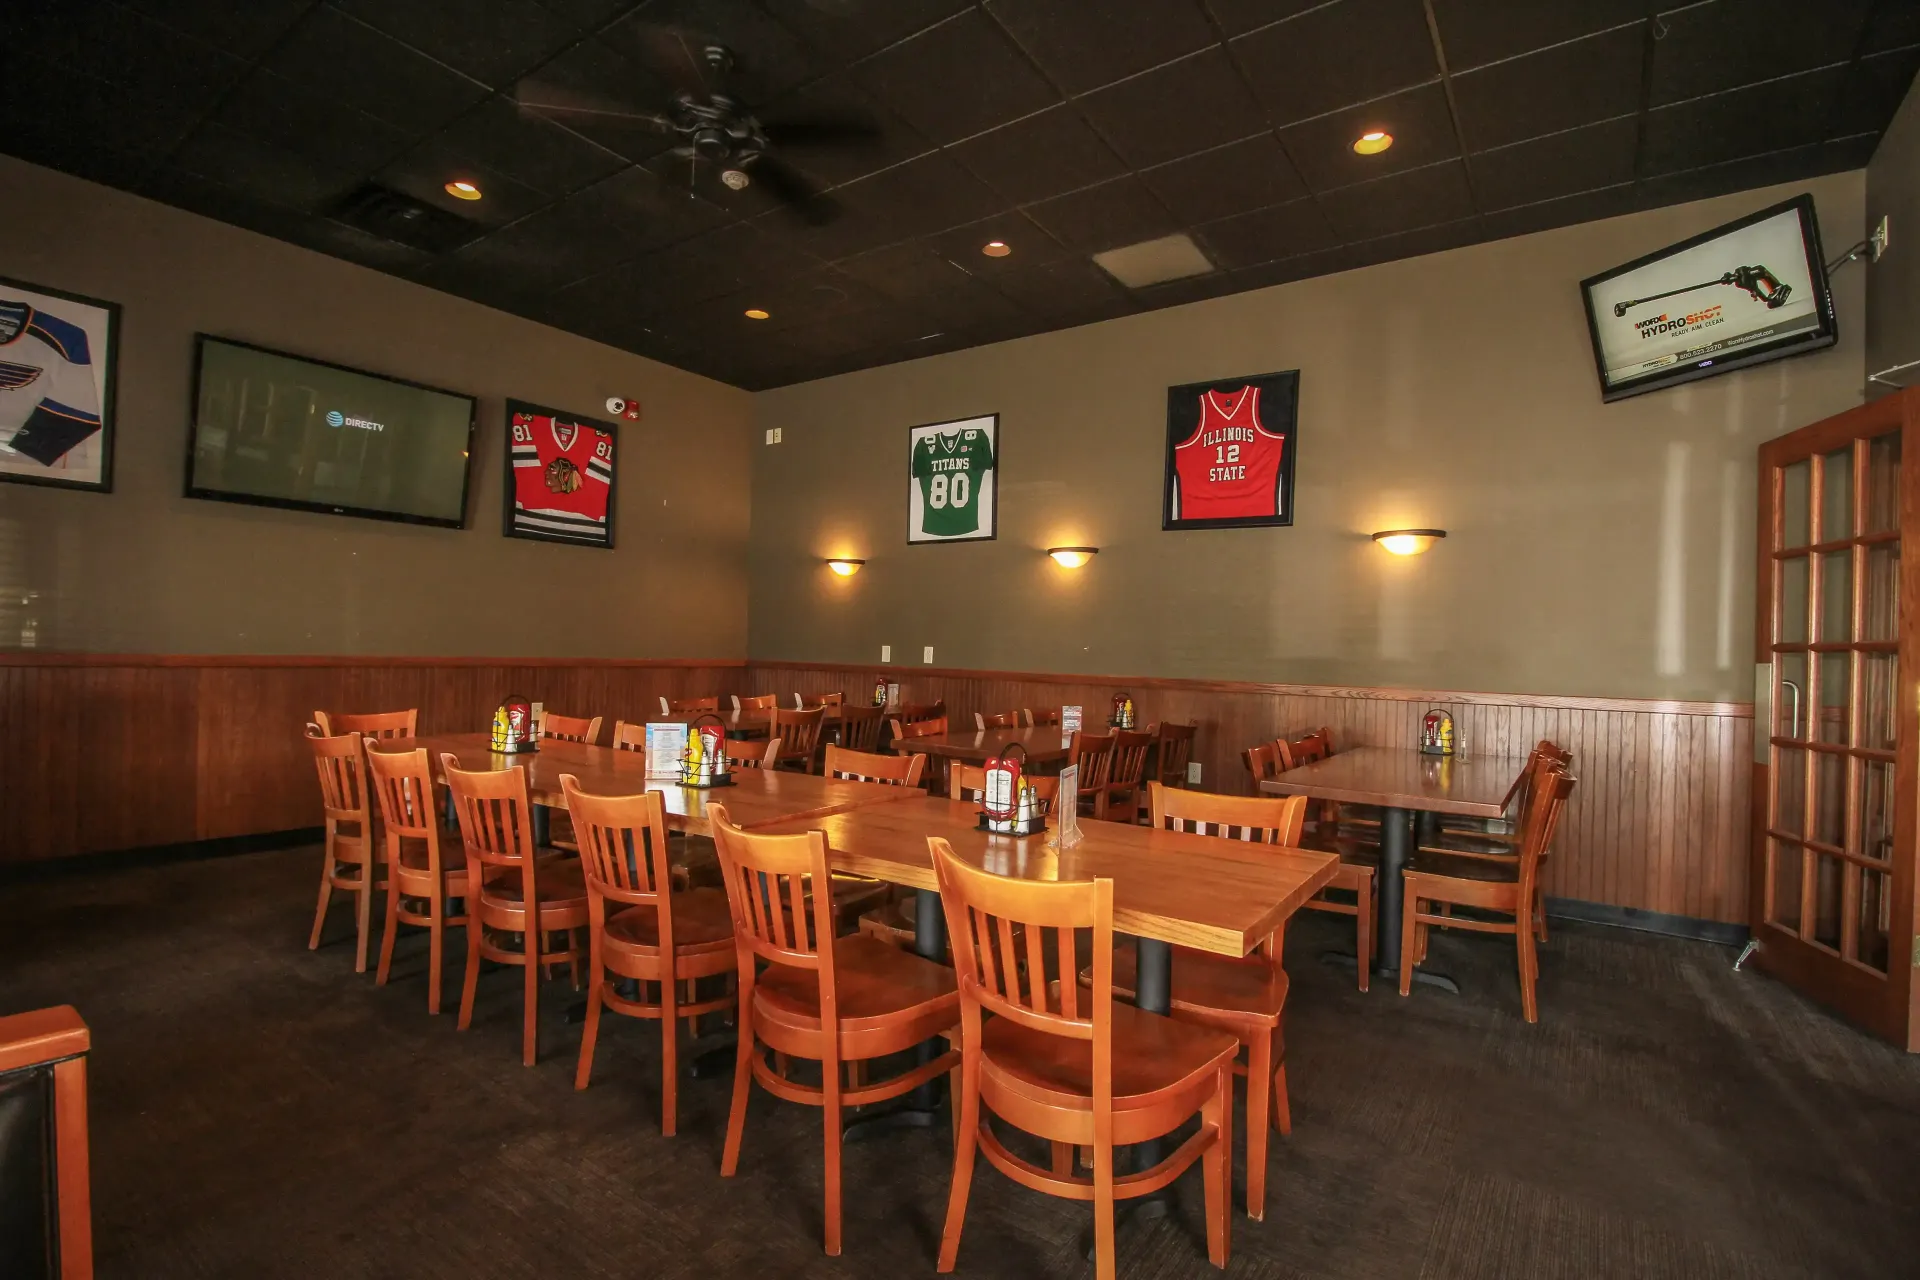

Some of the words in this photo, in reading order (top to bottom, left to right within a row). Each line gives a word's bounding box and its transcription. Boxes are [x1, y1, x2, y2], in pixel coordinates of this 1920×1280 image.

[1641, 305, 1721, 339] HYDROSHOT
[345, 417, 384, 432] DIRECTV
[512, 424, 533, 442] 81
[1203, 427, 1254, 448] ILLINOIS
[596, 441, 613, 461] 81
[1215, 444, 1240, 464] 12
[931, 457, 970, 472] TITANS
[1209, 465, 1246, 482] STATE
[929, 472, 970, 509] 80
